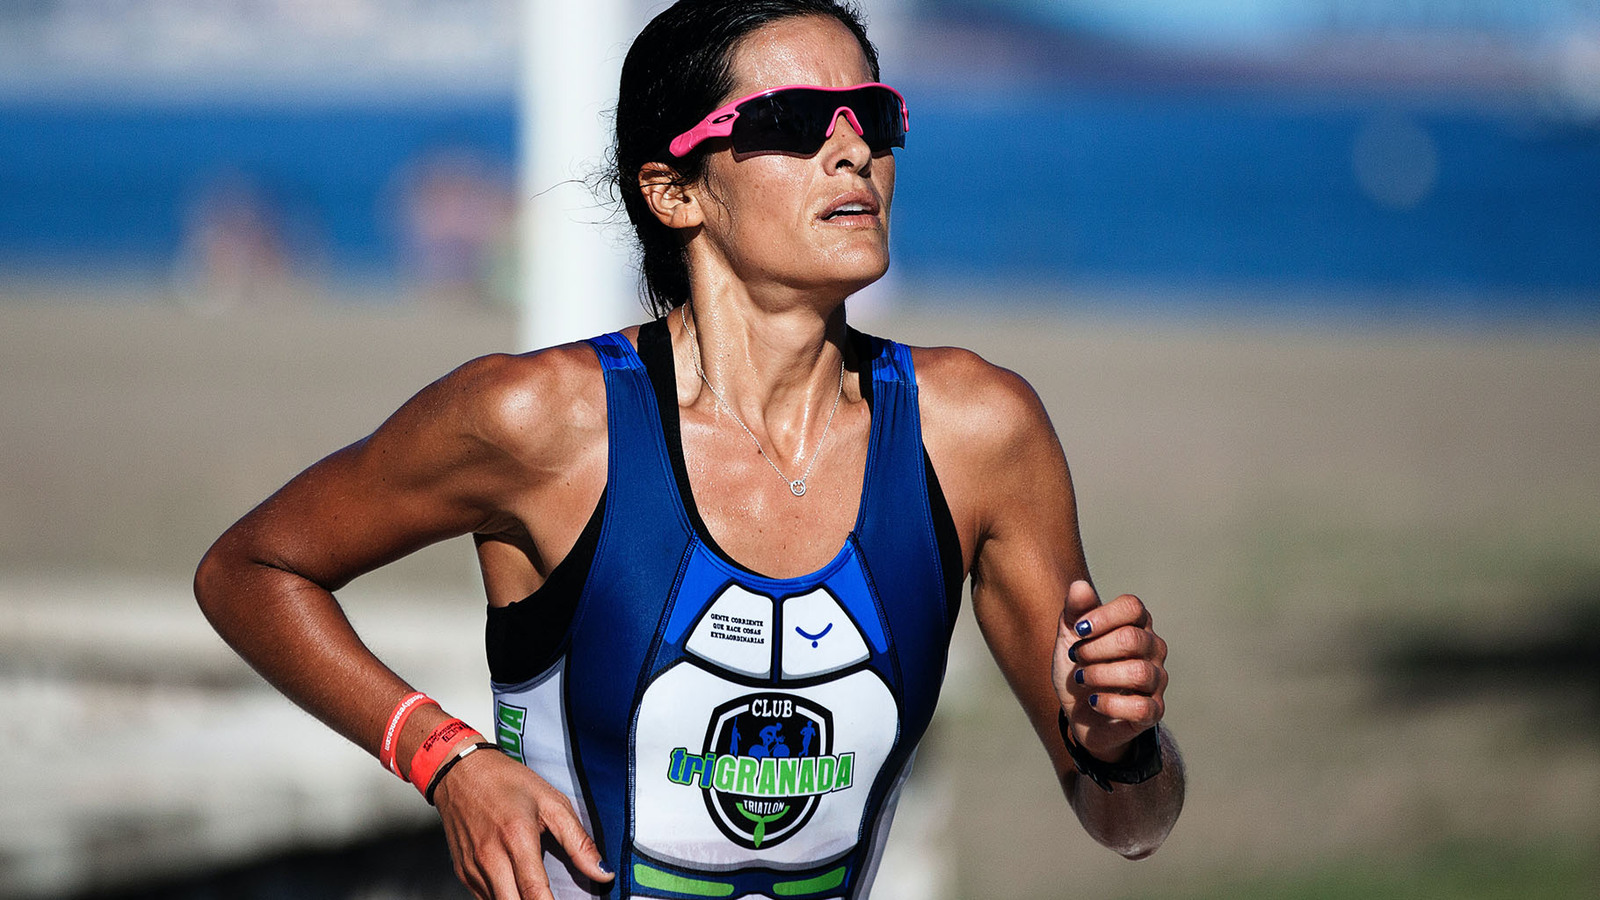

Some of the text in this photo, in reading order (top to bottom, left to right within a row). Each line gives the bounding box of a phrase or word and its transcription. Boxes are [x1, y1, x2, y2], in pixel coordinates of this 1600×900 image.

[710, 613, 764, 627] GENTE CORRIENTE
[713, 622, 762, 635] QUE HACE COSAS
[710, 631, 765, 644] EXTRAORDINARIAS
[751, 699, 793, 718] CLUB
